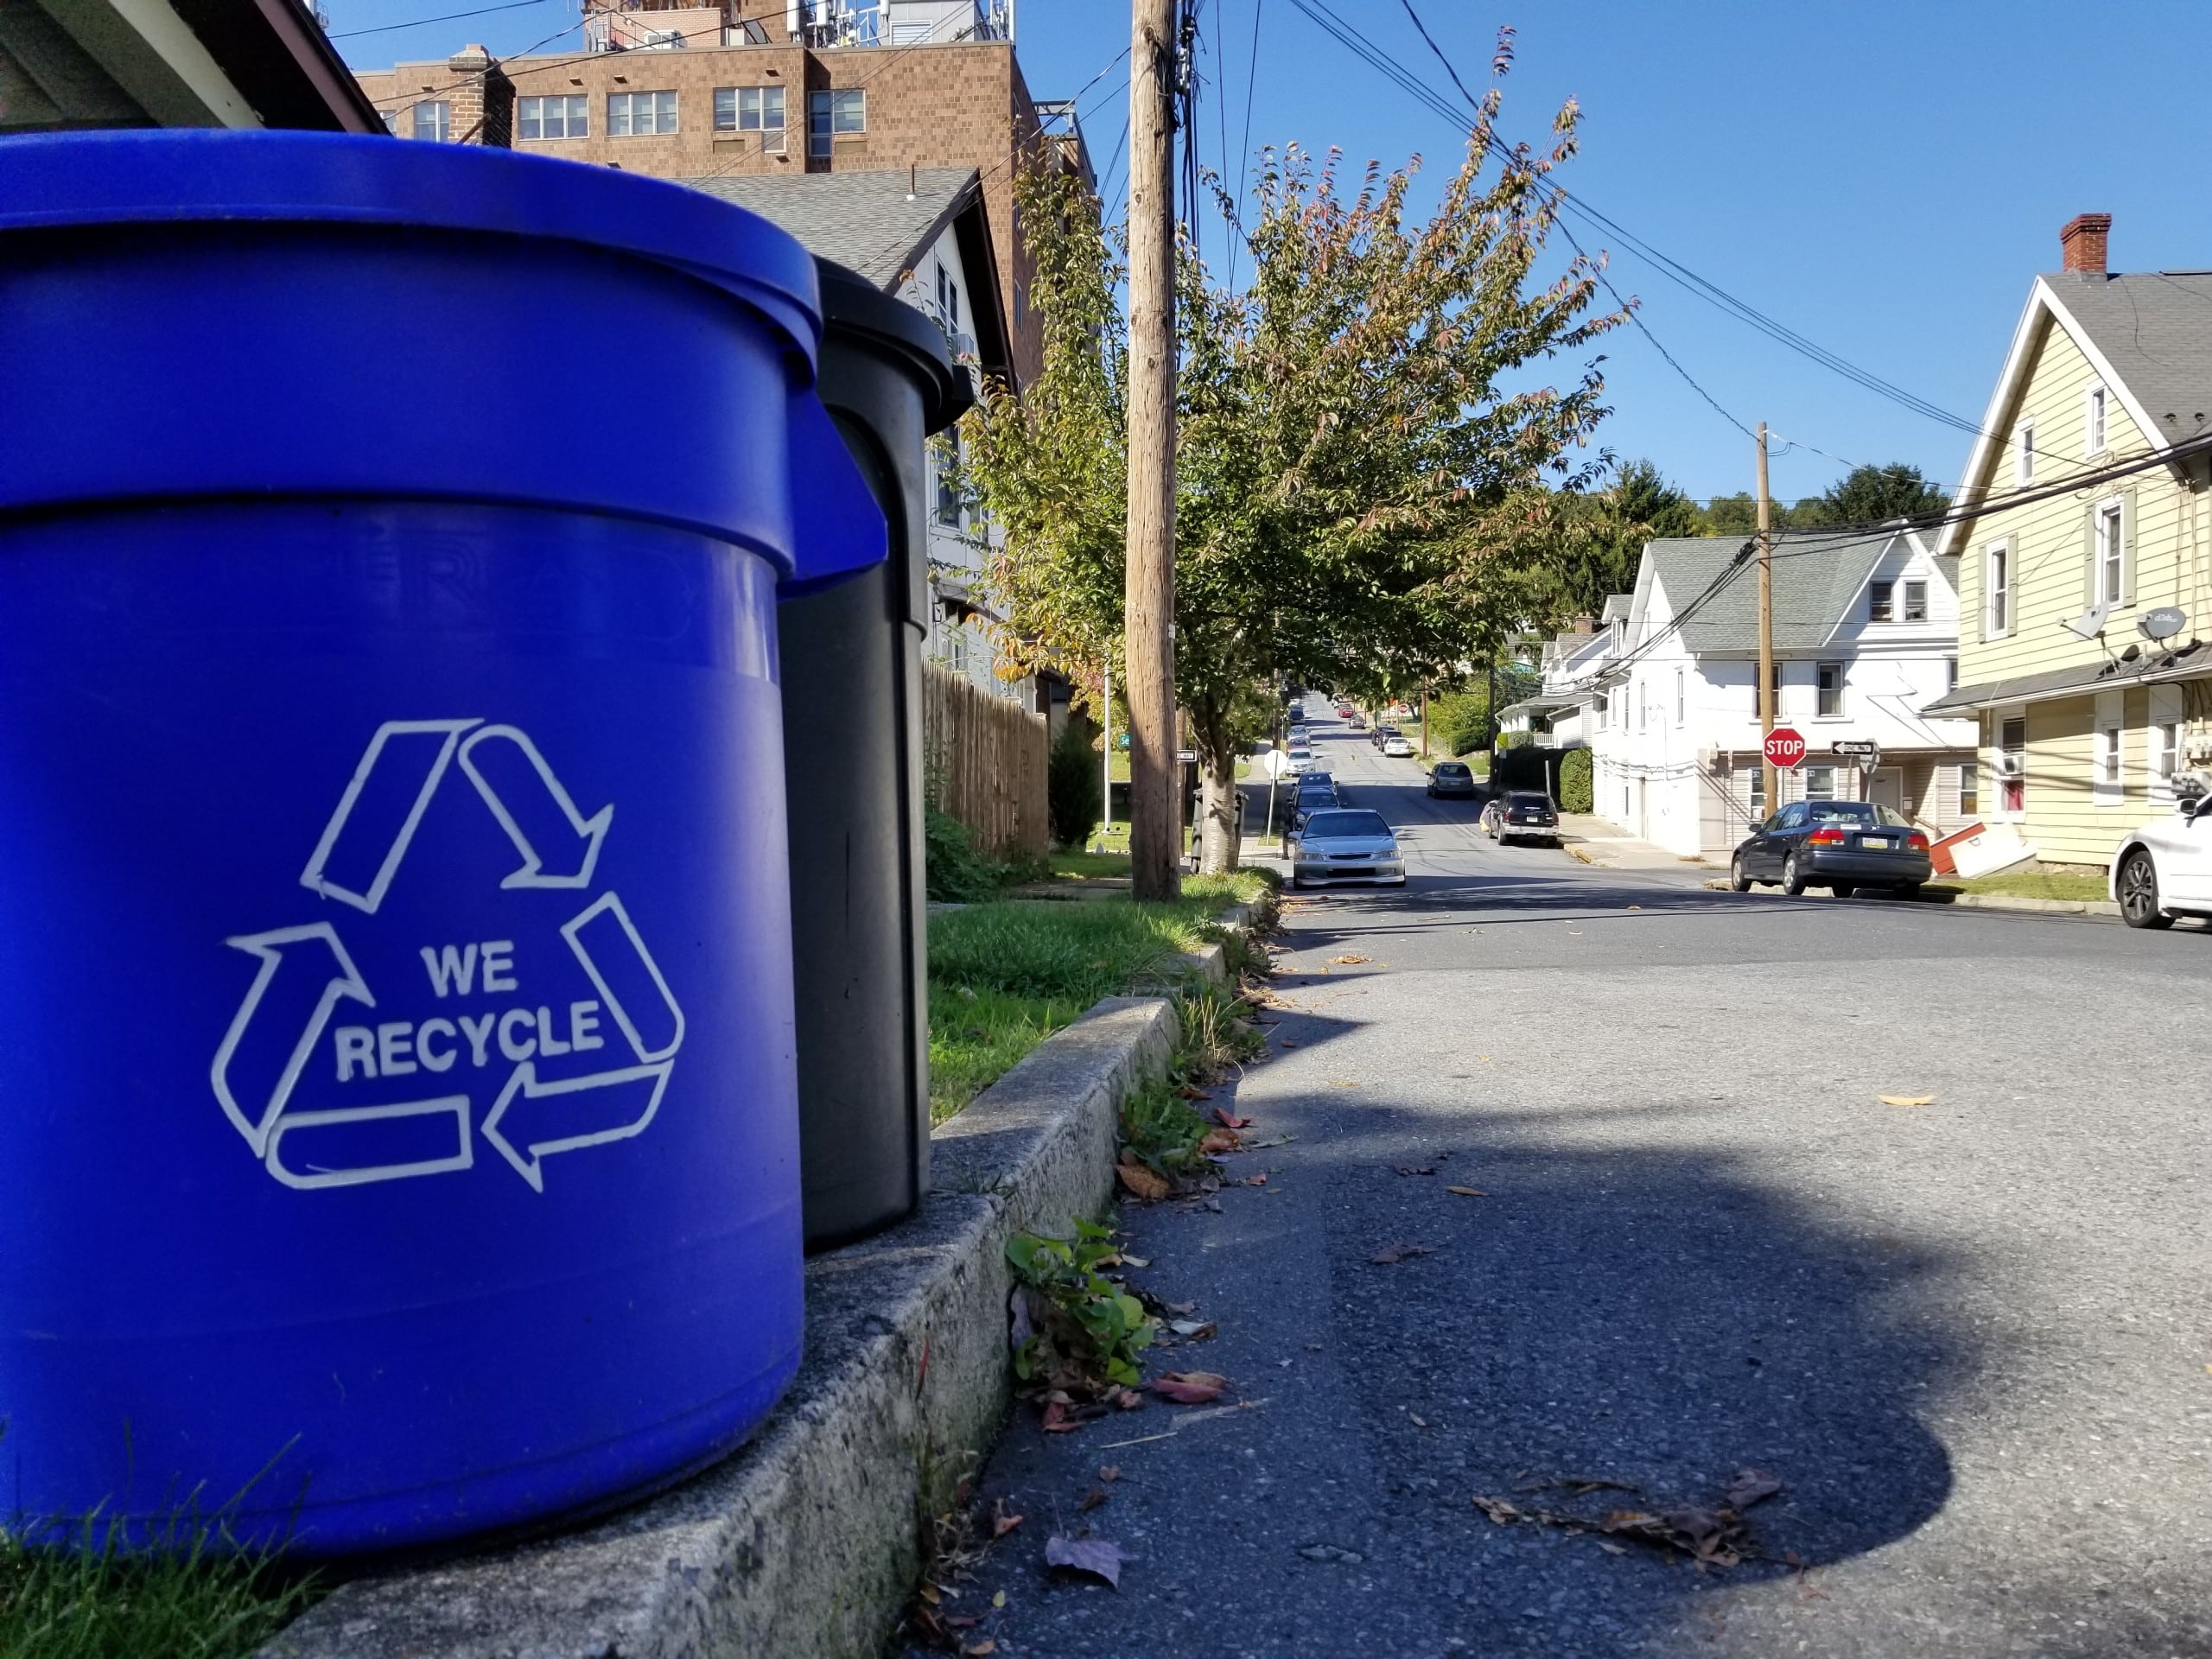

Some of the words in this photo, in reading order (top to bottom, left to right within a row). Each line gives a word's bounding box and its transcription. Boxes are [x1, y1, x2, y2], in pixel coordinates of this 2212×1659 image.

[1765, 740, 1803, 755] STOP
[419, 939, 518, 998] WE
[334, 1000, 604, 1083] RECYCLE
